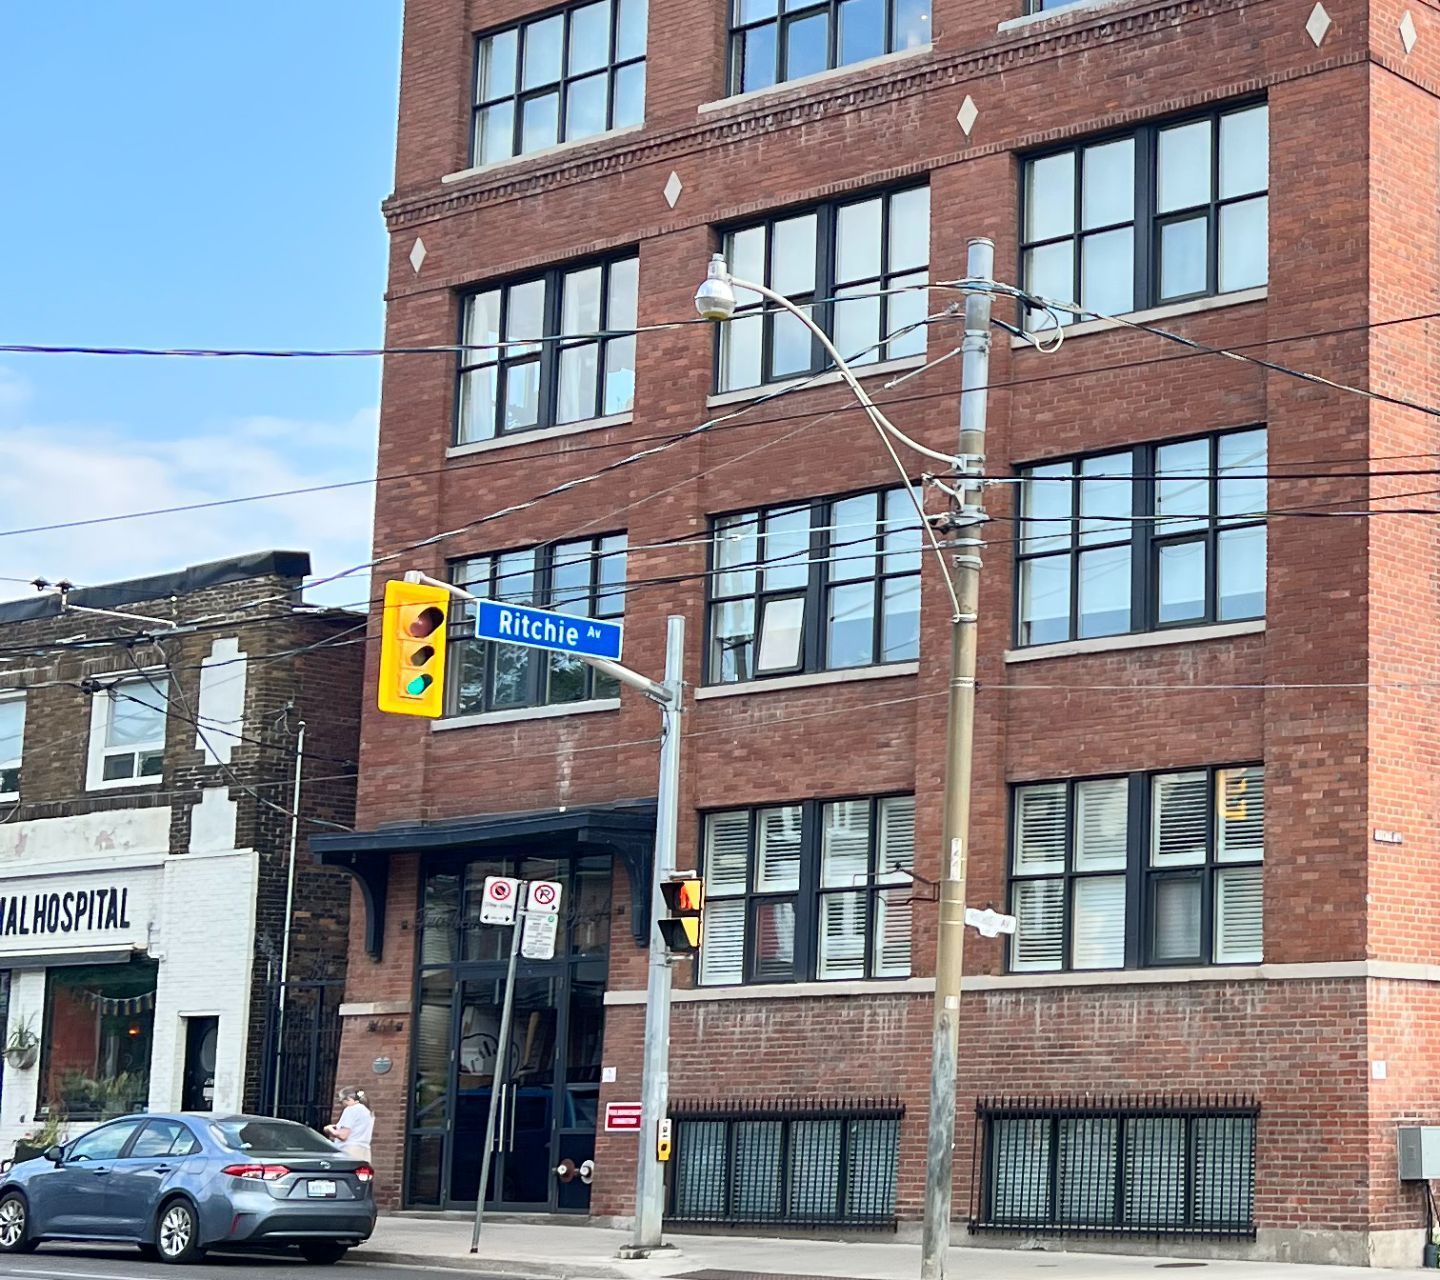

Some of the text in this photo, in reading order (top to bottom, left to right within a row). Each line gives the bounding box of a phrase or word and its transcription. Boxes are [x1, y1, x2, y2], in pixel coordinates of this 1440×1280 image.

[499, 610, 602, 646] Ritchie Av
[32, 886, 131, 934] HOSPITAL
